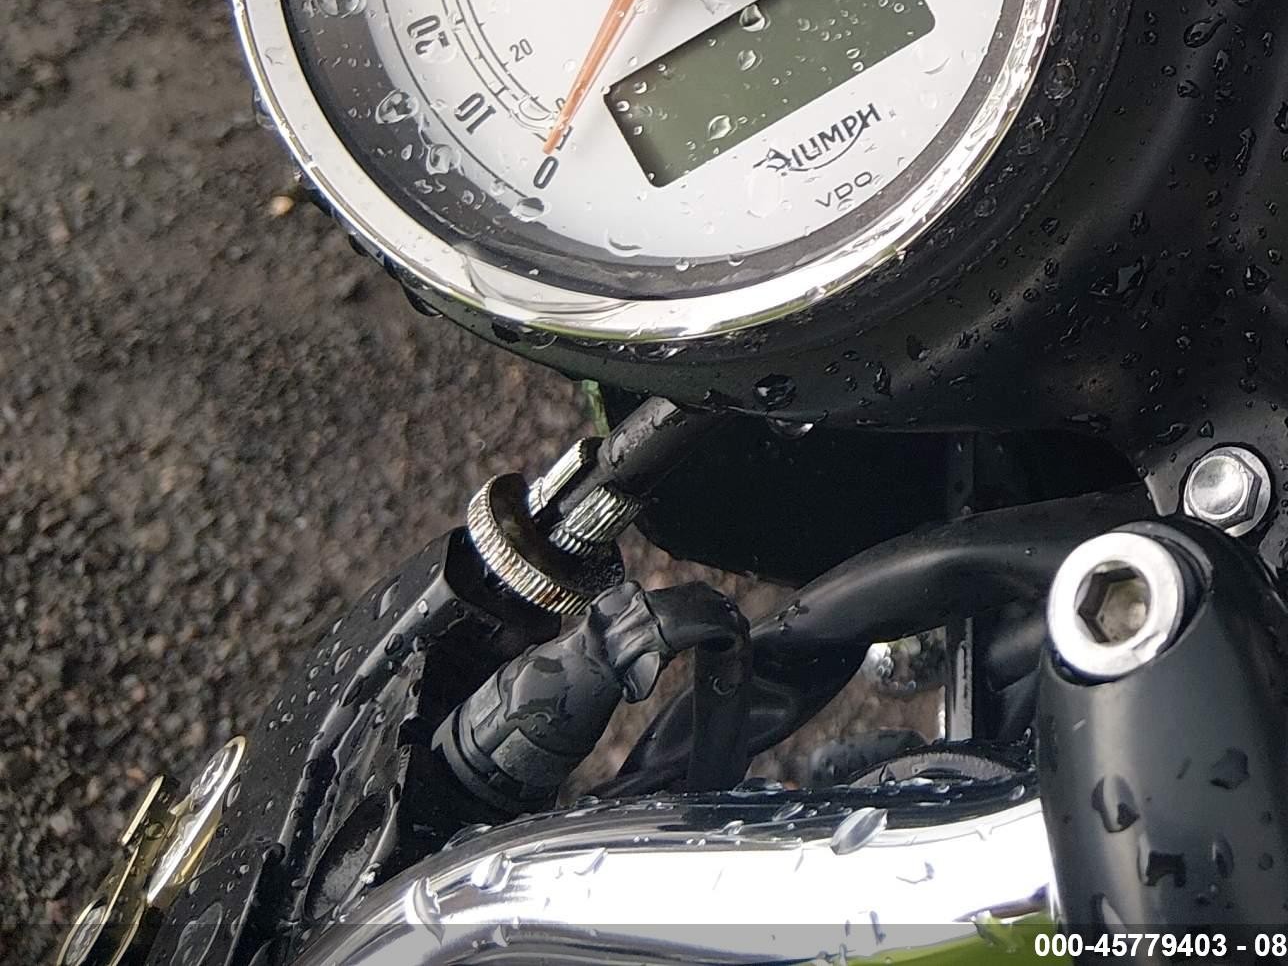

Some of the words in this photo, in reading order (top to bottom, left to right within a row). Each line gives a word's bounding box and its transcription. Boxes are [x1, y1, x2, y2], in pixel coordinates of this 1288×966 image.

[509, 38, 534, 63] 20
[454, 92, 496, 134] 10
[533, 156, 559, 189] 0
[815, 171, 872, 208] VDO
